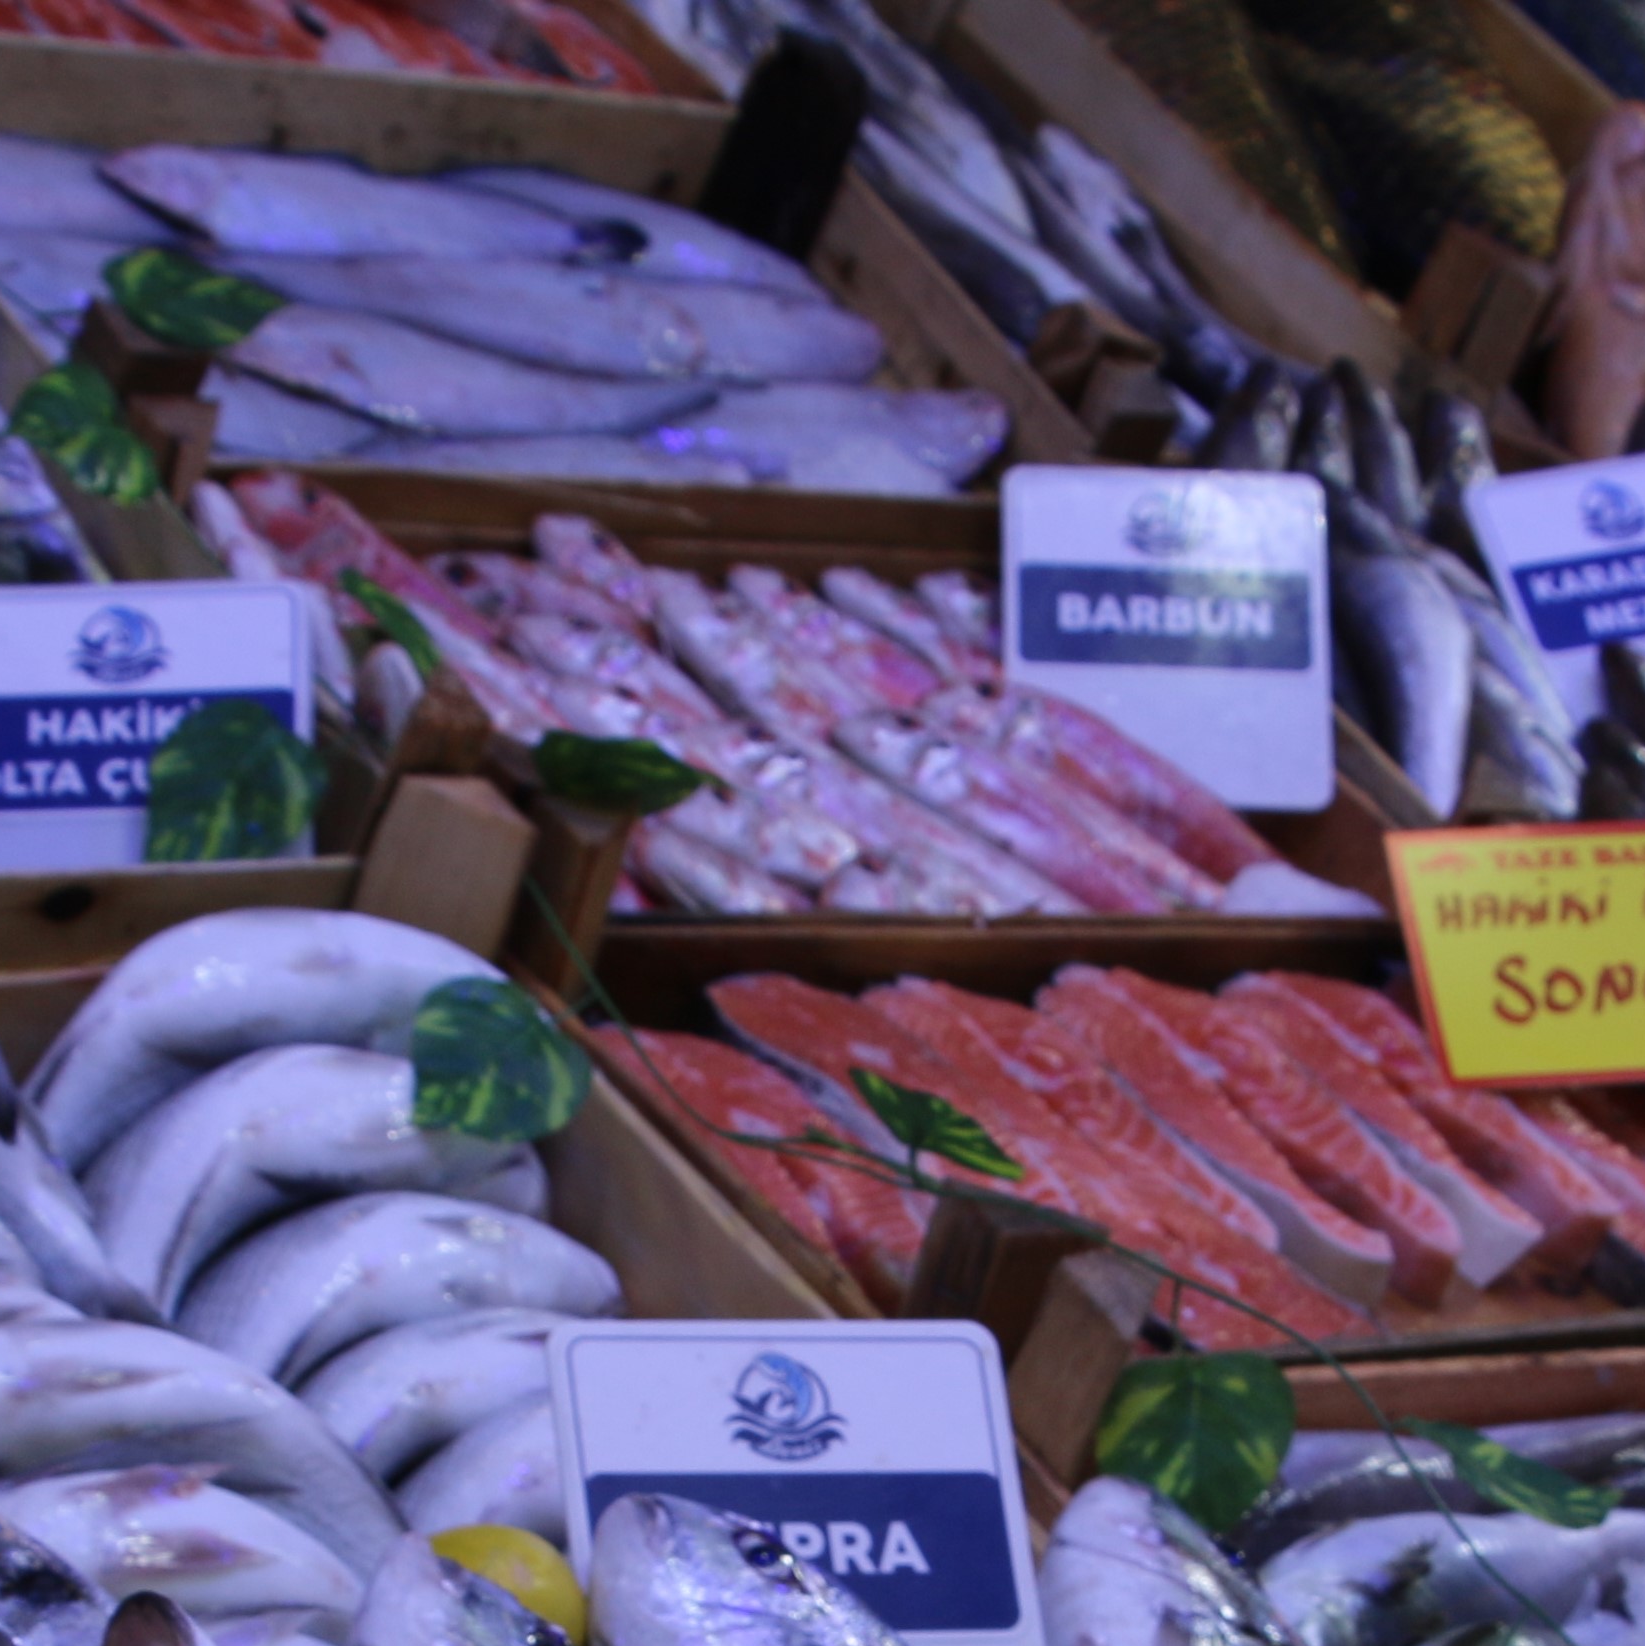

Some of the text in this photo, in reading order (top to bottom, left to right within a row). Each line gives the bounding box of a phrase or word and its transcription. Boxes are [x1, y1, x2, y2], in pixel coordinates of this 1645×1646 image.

[1056, 591, 1274, 640] BARBUN
[26, 697, 203, 746] HAKİK
[775, 1520, 931, 1575] PRA
